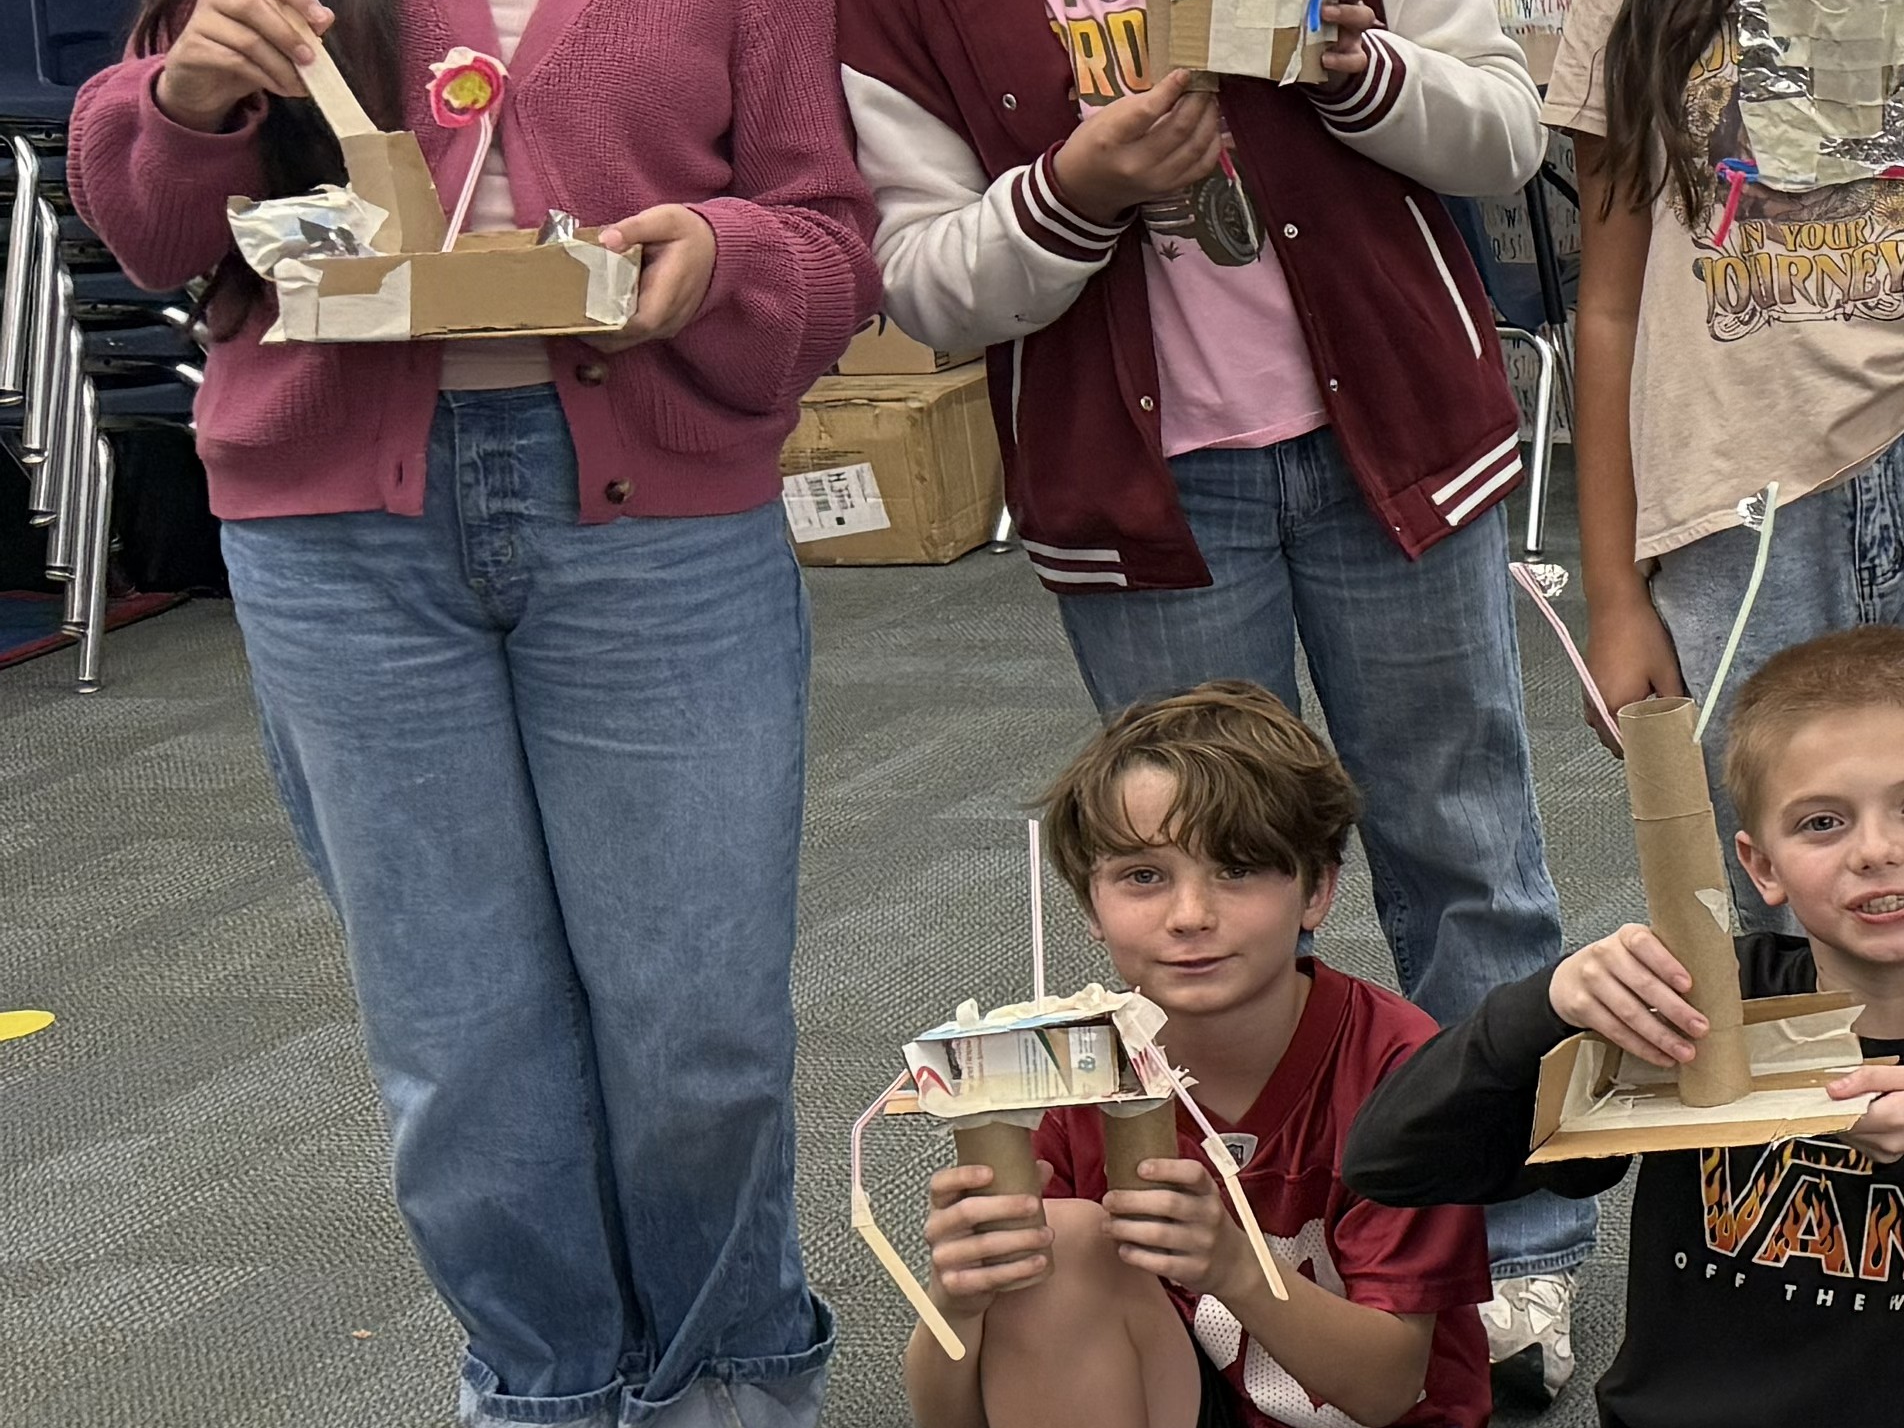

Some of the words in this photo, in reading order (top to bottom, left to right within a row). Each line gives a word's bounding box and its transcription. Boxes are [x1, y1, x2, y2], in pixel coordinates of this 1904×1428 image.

[1780, 218, 1867, 252] YOUR
[1674, 1252, 1747, 1289] OFF
[1784, 1283, 1867, 1311] THE
